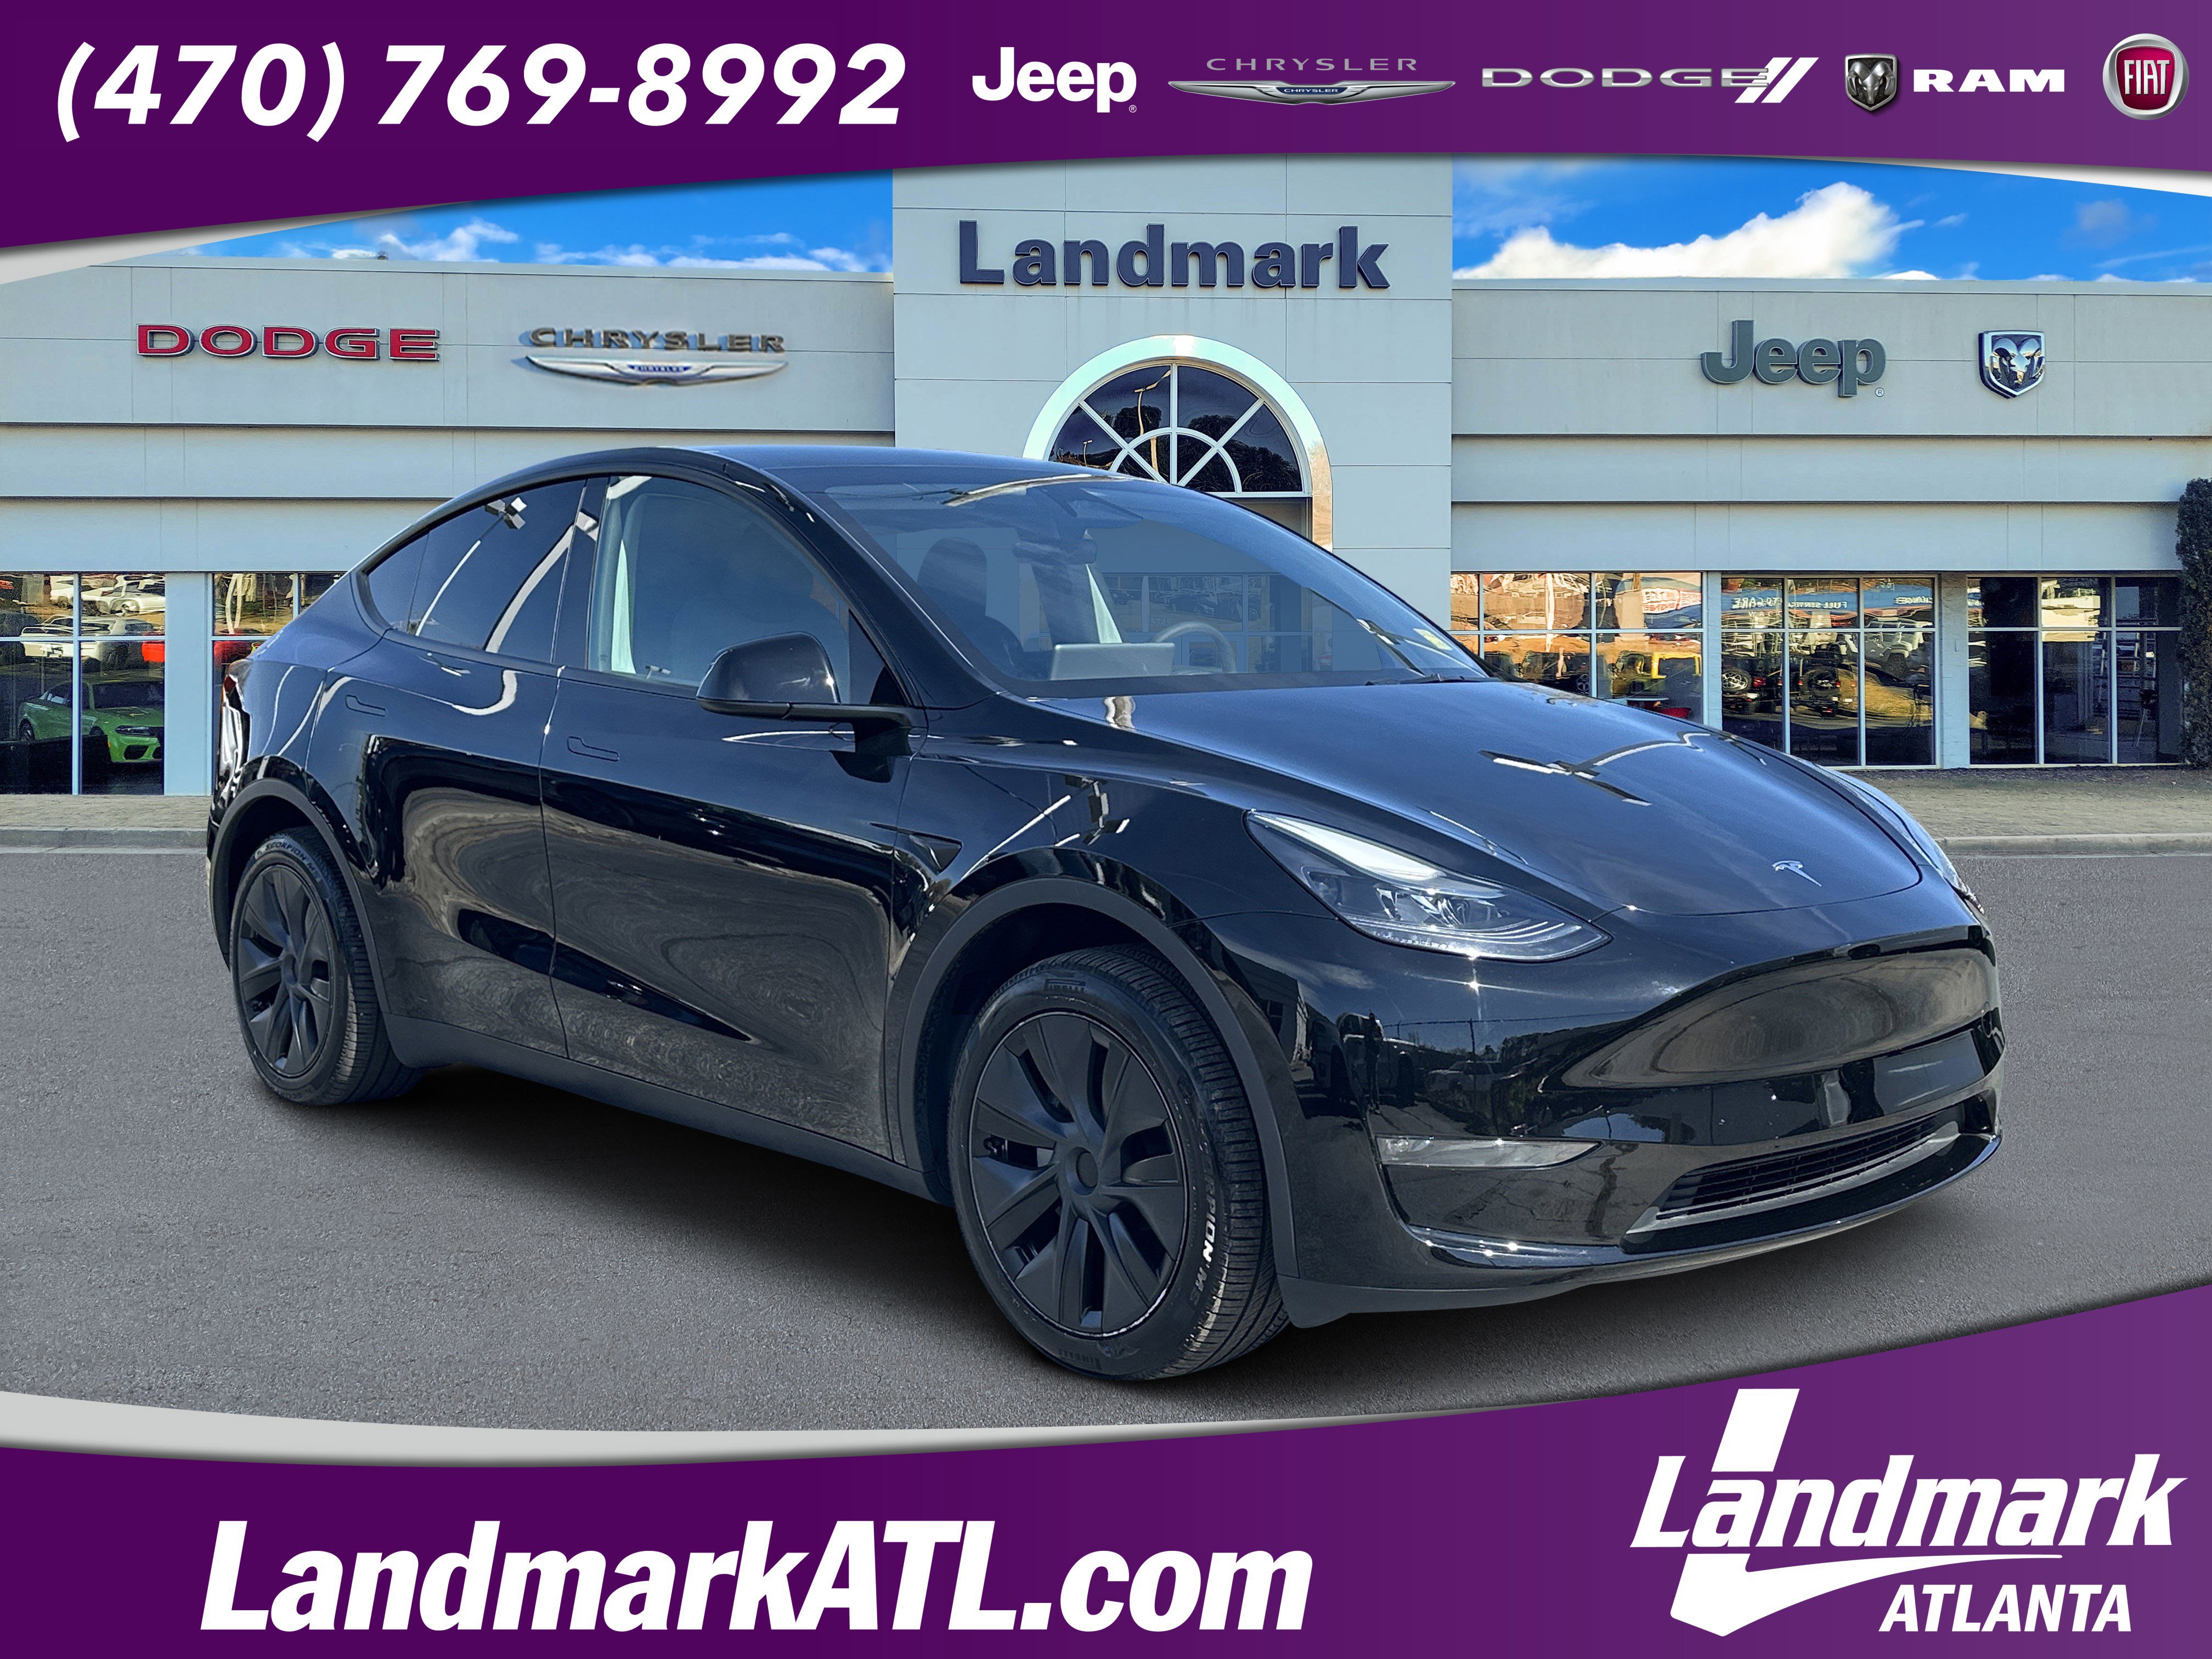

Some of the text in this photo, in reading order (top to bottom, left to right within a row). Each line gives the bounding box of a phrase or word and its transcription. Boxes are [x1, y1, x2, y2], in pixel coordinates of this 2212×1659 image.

[958, 218, 1391, 293] Landmark
[136, 323, 439, 361] DODGE
[529, 328, 786, 353] CHRYSLER
[1701, 319, 1886, 398] Jeep
[264, 842, 307, 861] SCORPION
